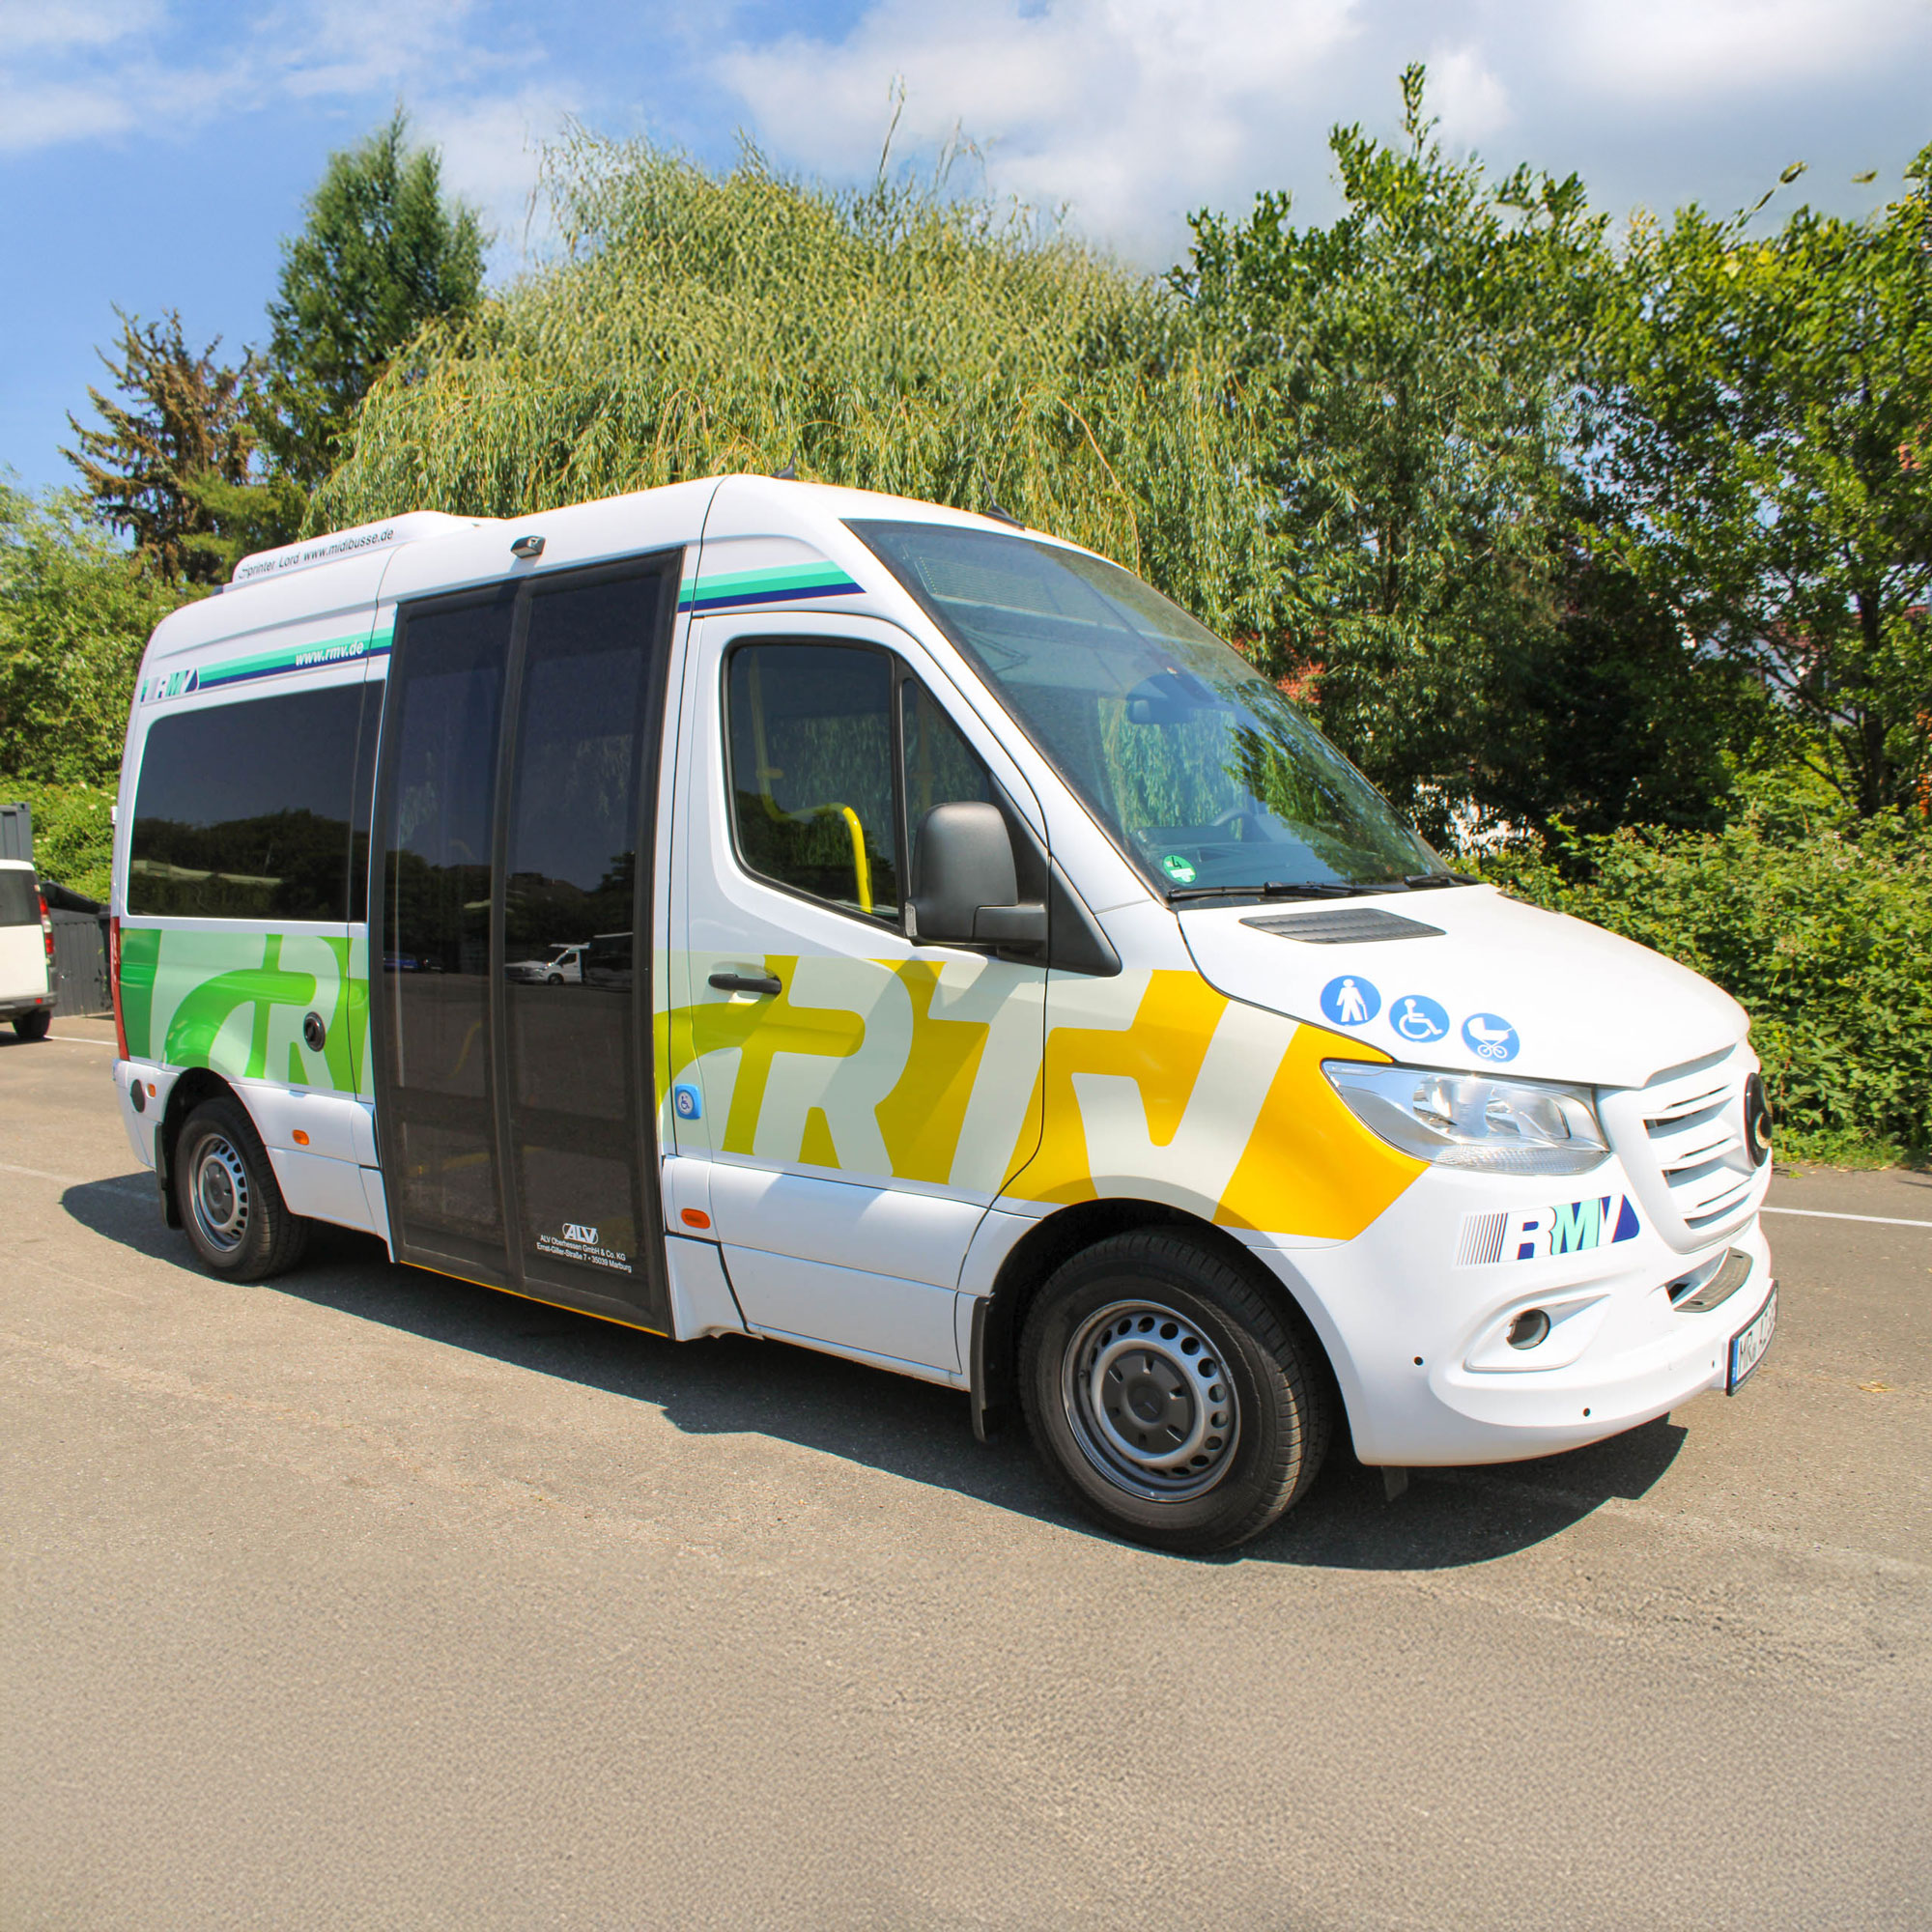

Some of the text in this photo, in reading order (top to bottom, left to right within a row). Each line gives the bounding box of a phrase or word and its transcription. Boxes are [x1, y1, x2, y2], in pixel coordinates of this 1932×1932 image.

[278, 552, 300, 568] Lord
[303, 528, 394, 561] www.midibusse.de
[295, 641, 364, 667] www.rmv.de
[563, 1224, 597, 1244] ALV
[1497, 1194, 1629, 1260] RMV
[540, 1235, 551, 1243] ALV
[551, 1237, 582, 1251] Oberhessen
[582, 1244, 600, 1255] GmbH
[606, 1250, 615, 1259] Co.
[616, 1252, 626, 1262] KG
[609, 1260, 632, 1273] Marburg
